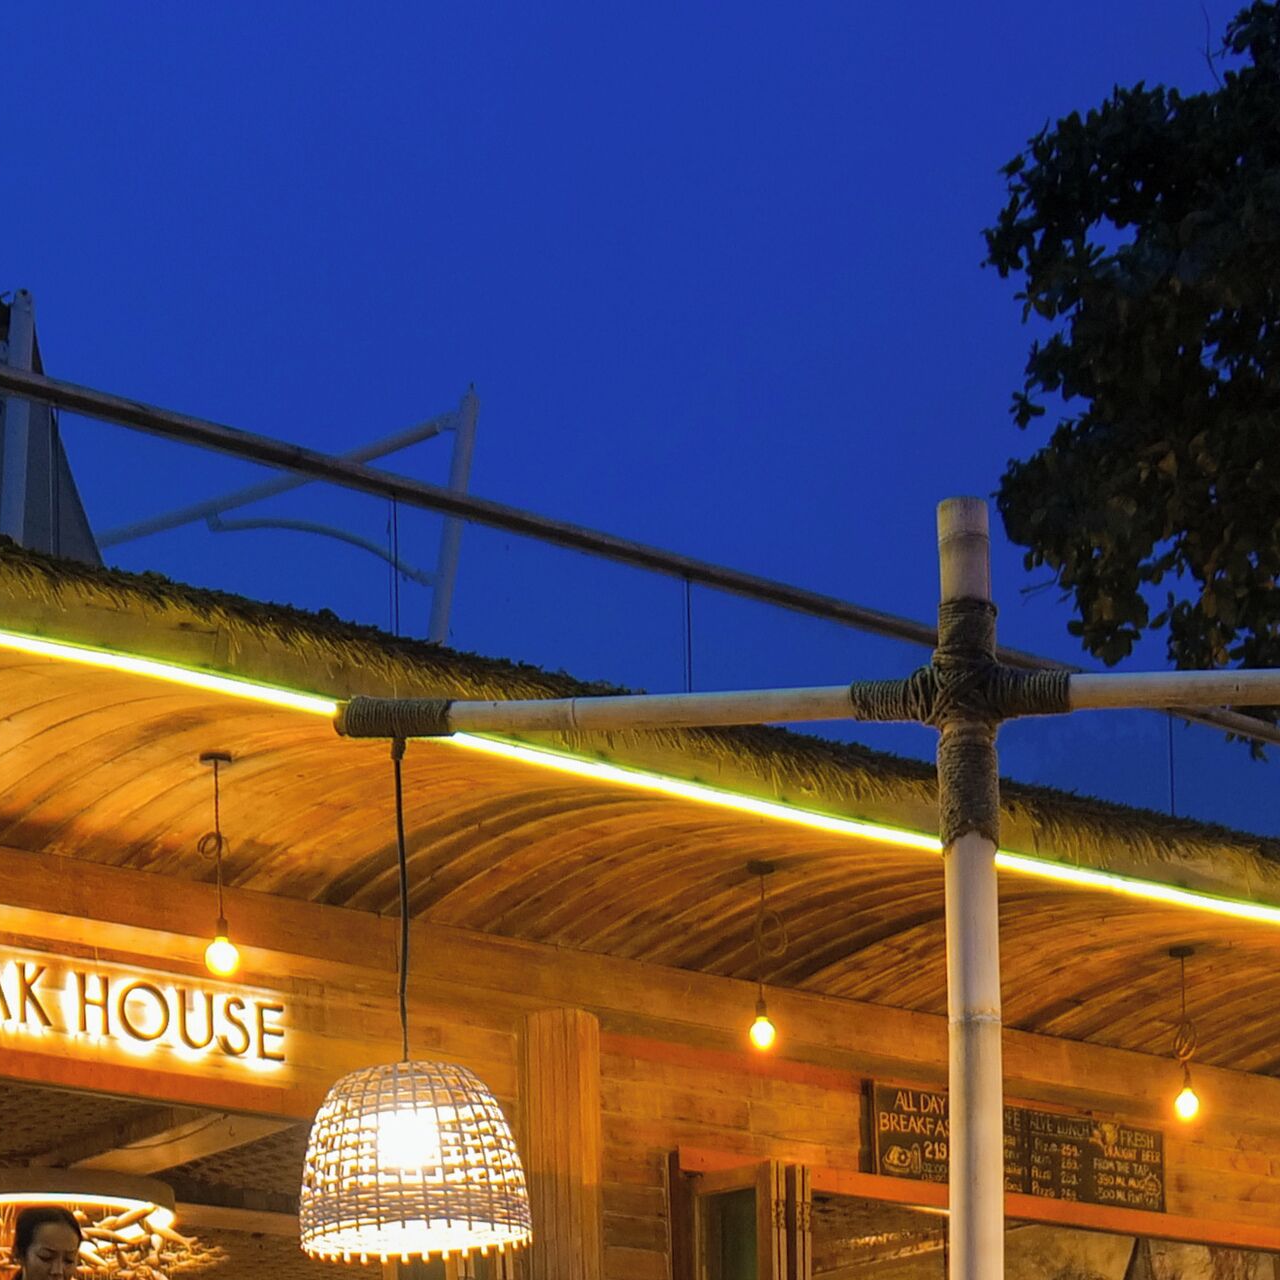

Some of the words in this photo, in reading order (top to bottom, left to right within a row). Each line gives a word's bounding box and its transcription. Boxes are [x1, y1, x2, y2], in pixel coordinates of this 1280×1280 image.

[73, 970, 286, 1062] HOUSE
[894, 1090, 917, 1112] ALL
[920, 1093, 946, 1116] DAY
[1120, 1130, 1154, 1149] FRESH
